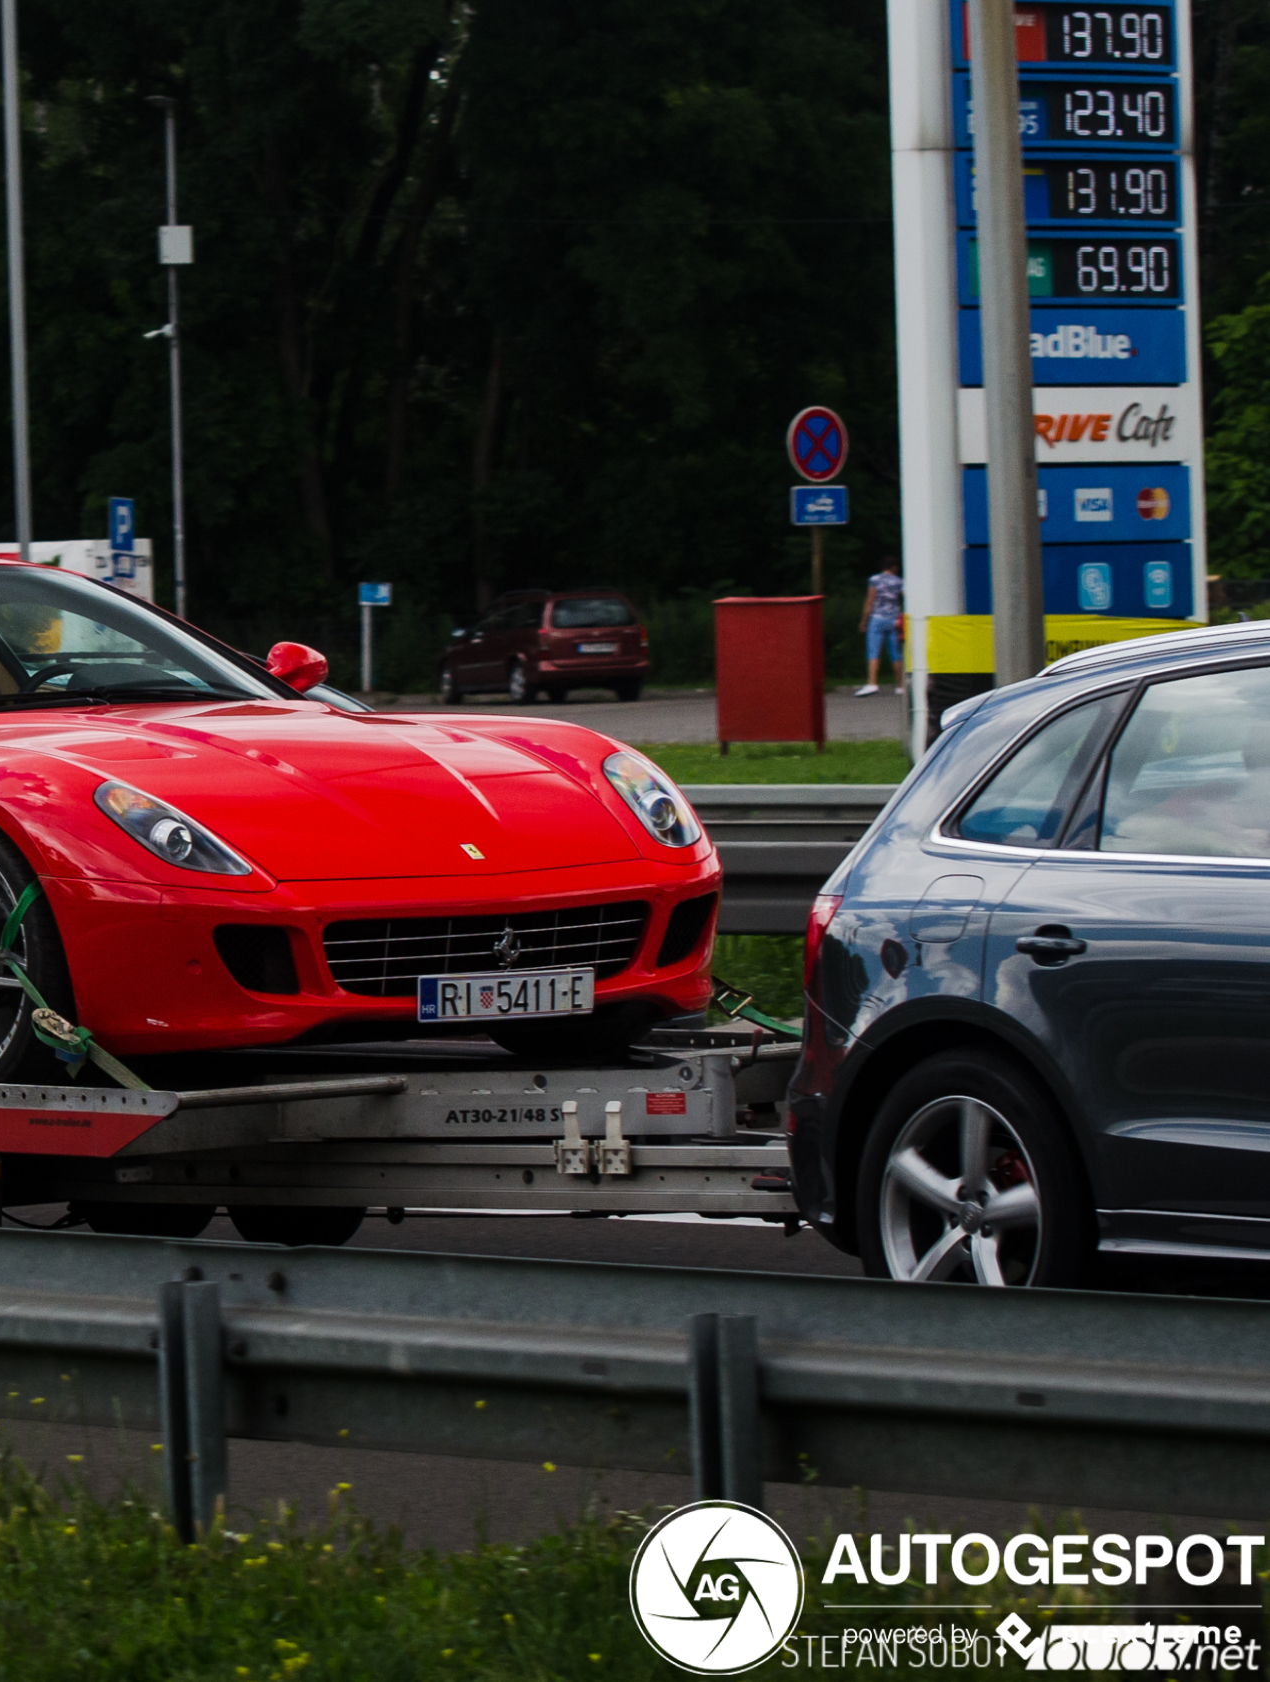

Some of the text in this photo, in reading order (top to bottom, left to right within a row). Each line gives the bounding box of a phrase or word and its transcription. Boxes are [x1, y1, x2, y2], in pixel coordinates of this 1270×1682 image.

[1061, 11, 1163, 60] 137.90
[1065, 90, 1165, 137] 123.40
[1068, 168, 1167, 215] 131.90
[1077, 246, 1169, 292] 69.90
[1033, 414, 1112, 448] RIVE
[421, 1004, 436, 1014] HR
[445, 1108, 546, 1124] AT30-21/48
